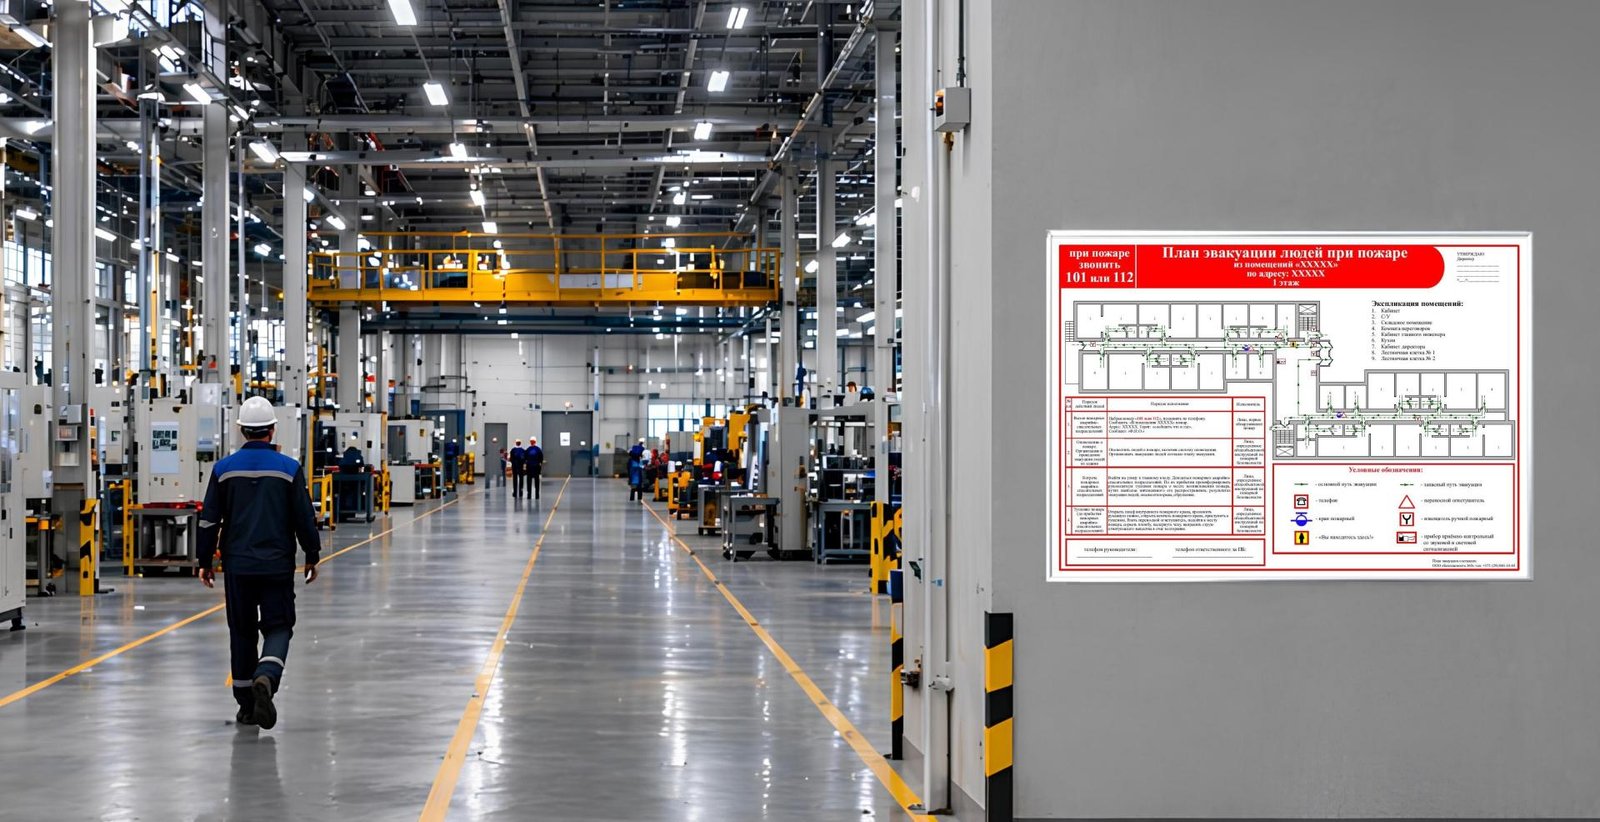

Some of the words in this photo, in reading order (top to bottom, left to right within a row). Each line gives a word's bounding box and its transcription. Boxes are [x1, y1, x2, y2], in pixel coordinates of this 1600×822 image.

[1069, 250, 1089, 259] при
[1092, 250, 1130, 259] пожаре
[1162, 246, 1199, 258] План
[1203, 248, 1276, 261] эвакуации
[1280, 246, 1323, 260] людей
[1327, 249, 1353, 261] при
[1358, 249, 1408, 261] пожаре
[1245, 261, 1293, 269] помещений
[1065, 272, 1087, 283] 101
[1090, 275, 1110, 283] или
[1113, 272, 1134, 283] 112
[1259, 271, 1289, 279] адресу:
